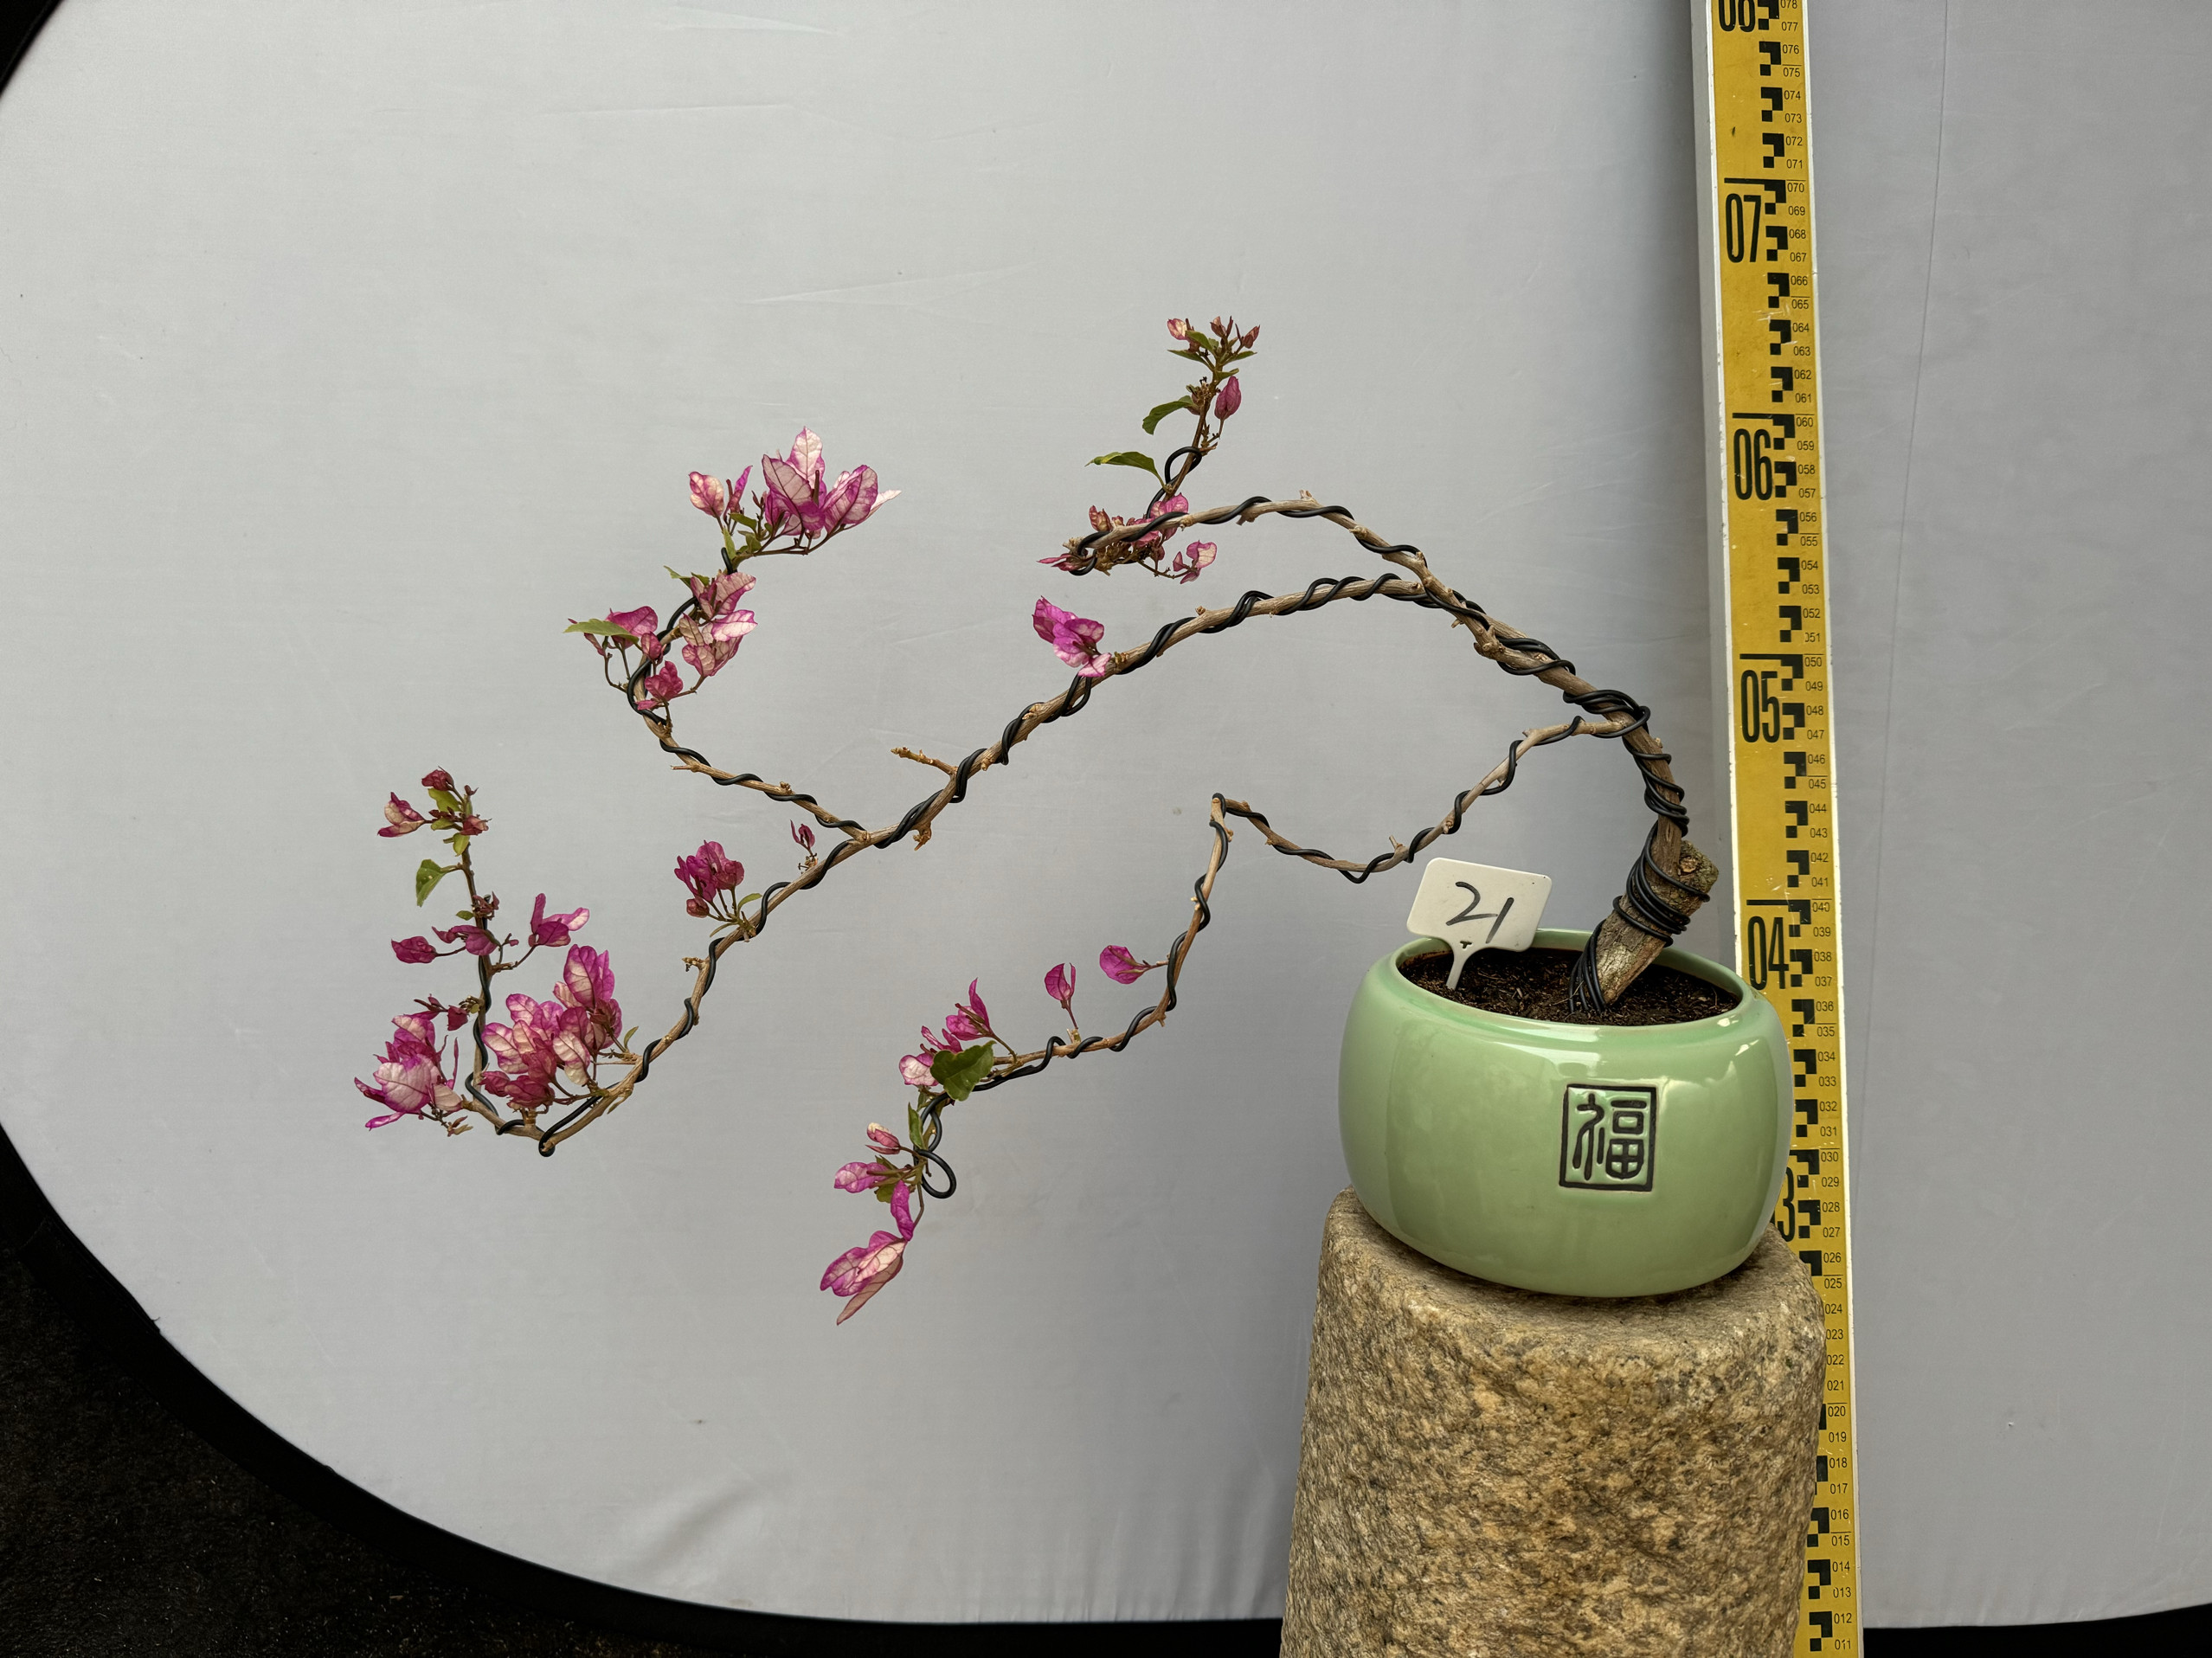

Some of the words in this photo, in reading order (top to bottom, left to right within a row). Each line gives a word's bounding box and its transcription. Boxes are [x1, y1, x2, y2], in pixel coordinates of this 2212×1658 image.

[1780, 0, 1797, 10] 078
[1781, 22, 1798, 32] 077
[1782, 44, 1800, 55] 076
[1783, 67, 1801, 77] 075
[1784, 90, 1801, 100] 074
[1784, 113, 1803, 123] 073
[1785, 136, 1803, 146] 072
[1786, 159, 1803, 169] 071
[1787, 183, 1804, 192] 070
[1788, 206, 1805, 215] 069
[1726, 193, 1761, 263] 07
[1789, 229, 1806, 239] 068
[1790, 253, 1807, 262] 067
[1791, 276, 1808, 286] 066
[1791, 299, 1809, 310] 065
[1792, 323, 1810, 332] 064
[1793, 346, 1811, 357] 063
[1794, 370, 1812, 380] 062
[1795, 393, 1812, 403] 061
[1796, 417, 1813, 427] 060
[1797, 440, 1815, 451] 059
[1733, 428, 1773, 500] 06
[1797, 465, 1816, 474] 058
[1798, 488, 1816, 498] 057
[1799, 512, 1817, 522] 056
[1800, 536, 1818, 546] 055
[1801, 560, 1818, 570] 054
[1802, 584, 1820, 594] 053
[1803, 608, 1821, 618] 052
[1804, 657, 1823, 667] 050
[1805, 681, 1823, 691] 049
[1740, 669, 1780, 742] 05
[1806, 705, 1824, 716] 048
[1807, 729, 1824, 740] 047
[1808, 755, 1825, 764] 046
[1809, 779, 1826, 789] 045
[1810, 803, 1827, 813] 044
[1810, 828, 1828, 838] 043
[1810, 852, 1829, 863] 042
[1811, 877, 1829, 887] 041
[1812, 902, 1830, 912] 040
[1445, 881, 1514, 944] 21
[1813, 927, 1831, 937] 039
[1747, 916, 1790, 990] 04
[1814, 952, 1832, 961] 038
[1815, 976, 1832, 986] 037
[1816, 1001, 1834, 1012] 036
[1817, 1026, 1835, 1037] 035
[1817, 1051, 1836, 1062] 034
[1818, 1076, 1836, 1087] 033
[1819, 1102, 1837, 1111] 032
[1572, 1092, 1648, 1180] 福
[1820, 1127, 1837, 1136] 031
[1821, 1152, 1839, 1162] 030
[1822, 1177, 1839, 1187] 029
[1823, 1202, 1840, 1212] 028
[1823, 1227, 1841, 1237] 027
[1823, 1252, 1842, 1263] 026
[1824, 1278, 1842, 1288] 025
[1825, 1303, 1842, 1314] 024
[1826, 1329, 1843, 1340] 023
[1826, 1354, 1844, 1365] 022
[1827, 1380, 1844, 1391] 021
[1828, 1406, 1846, 1417] 020
[1829, 1432, 1847, 1443] 019
[1829, 1457, 1848, 1468] 018
[1829, 1483, 1848, 1494] 017
[1830, 1509, 1849, 1520] 016
[1831, 1535, 1850, 1546] 015
[1832, 1561, 1850, 1571] 014
[1833, 1587, 1851, 1597] 013
[1834, 1613, 1852, 1623] 012
[1835, 1639, 1851, 1650] 011
